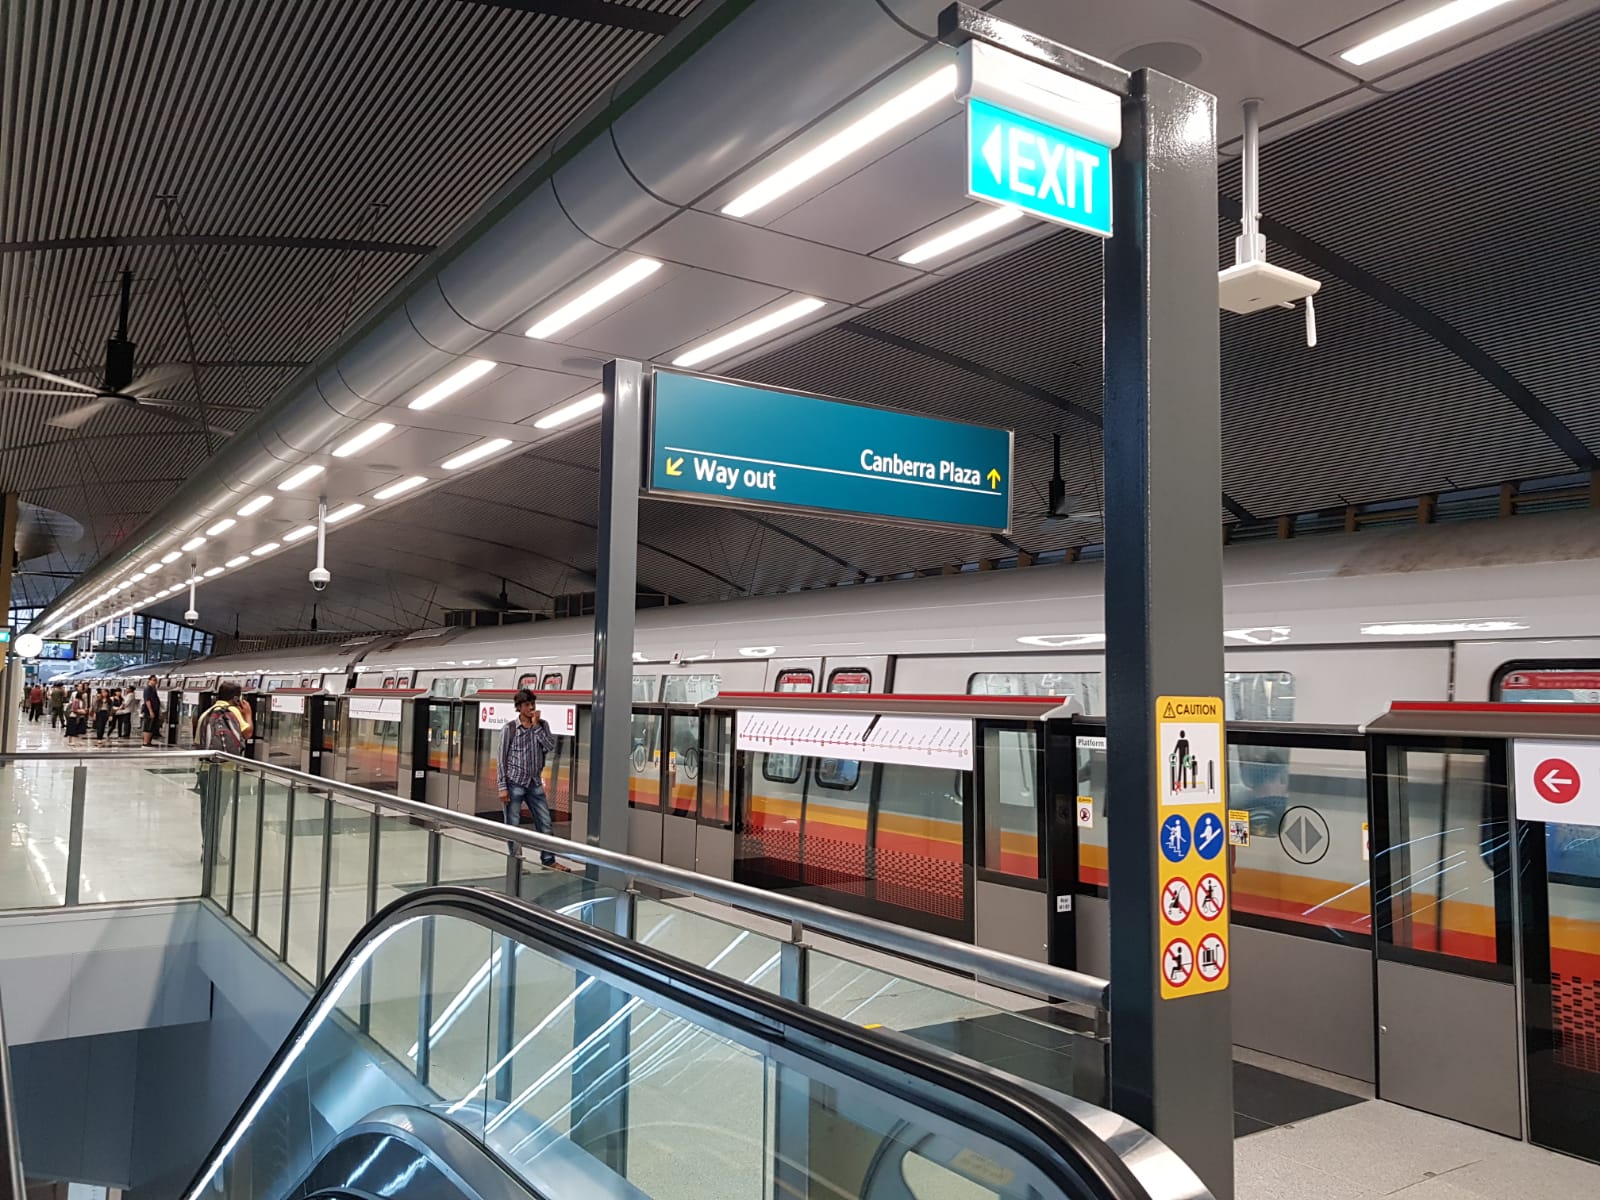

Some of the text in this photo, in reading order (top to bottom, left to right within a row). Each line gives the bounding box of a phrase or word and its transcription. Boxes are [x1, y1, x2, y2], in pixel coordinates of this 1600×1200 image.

[1010, 128, 1099, 213] EXIT
[694, 458, 776, 490] Way out
[860, 449, 980, 486] Canberra Plaza
[1176, 704, 1216, 716] CAUTION
[1078, 738, 1104, 747] Platform
